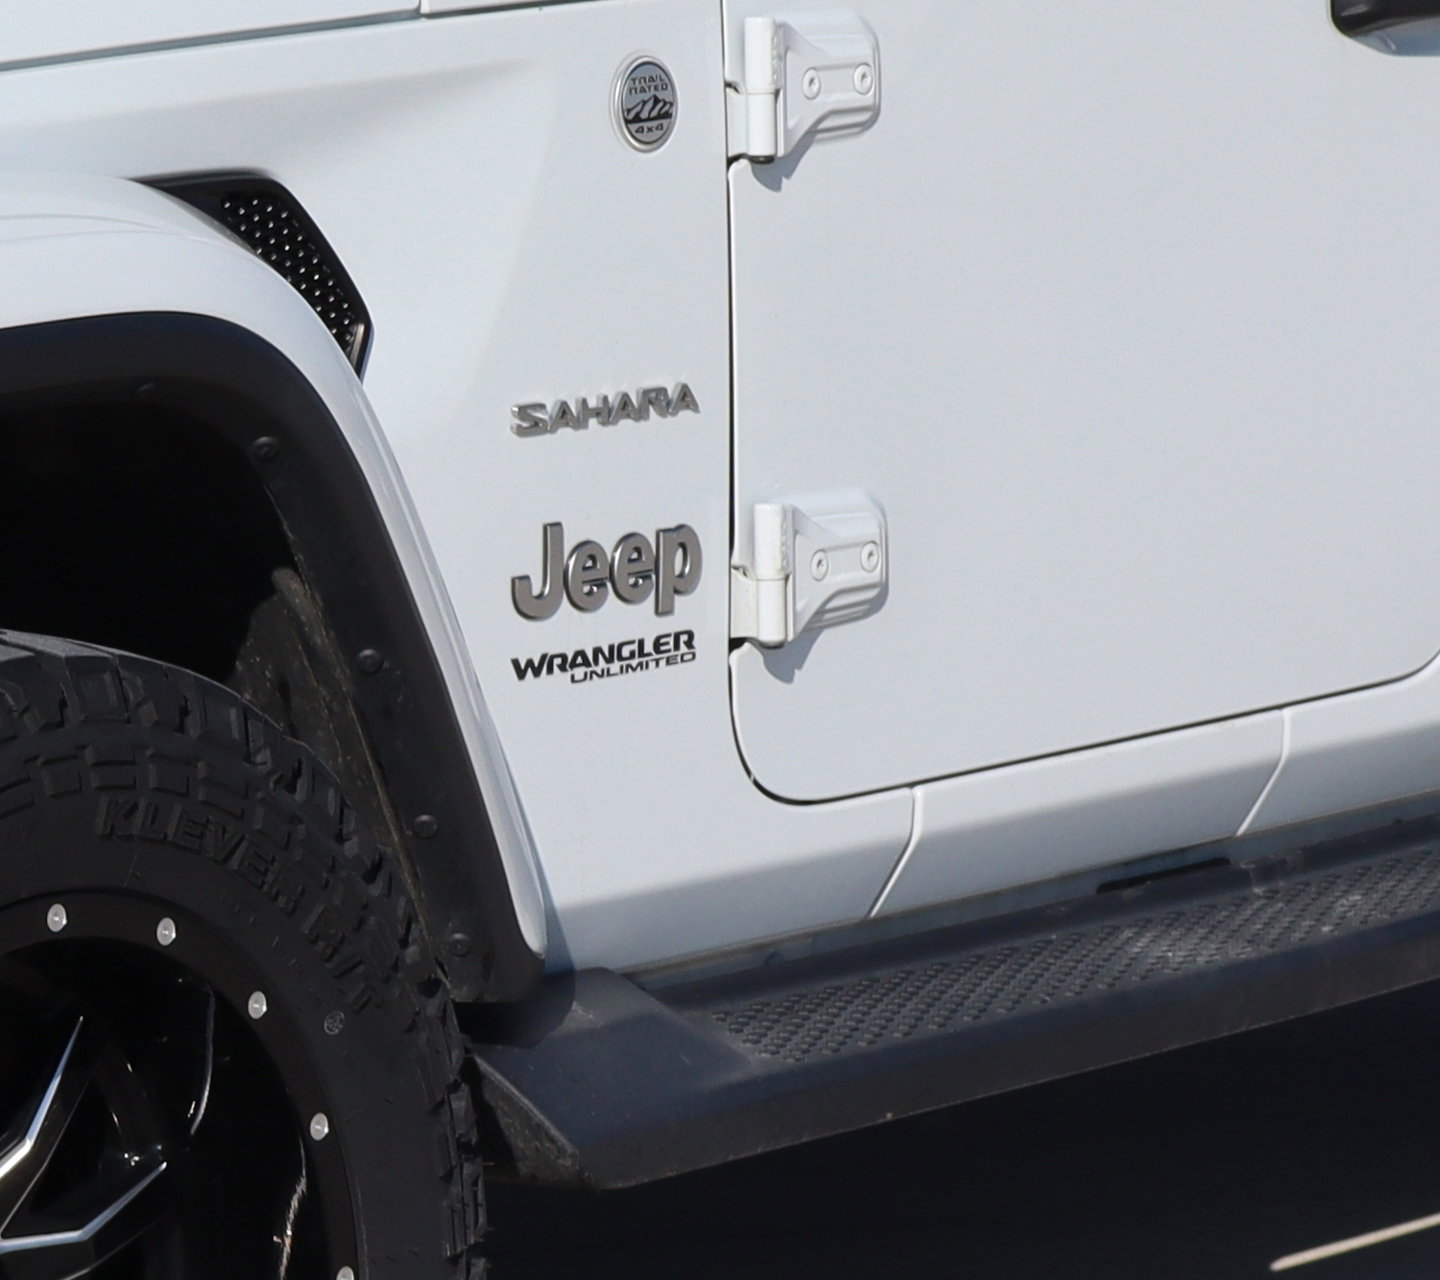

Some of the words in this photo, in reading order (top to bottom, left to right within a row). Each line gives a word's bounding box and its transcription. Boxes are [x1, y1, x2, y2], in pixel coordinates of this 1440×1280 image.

[628, 83, 669, 95] RATED
[630, 74, 665, 85] TRAIL
[511, 382, 701, 437] SAHARA
[511, 521, 703, 622] Jeep
[510, 629, 696, 681] WRANGLER
[570, 651, 697, 684] UNLIMITED
